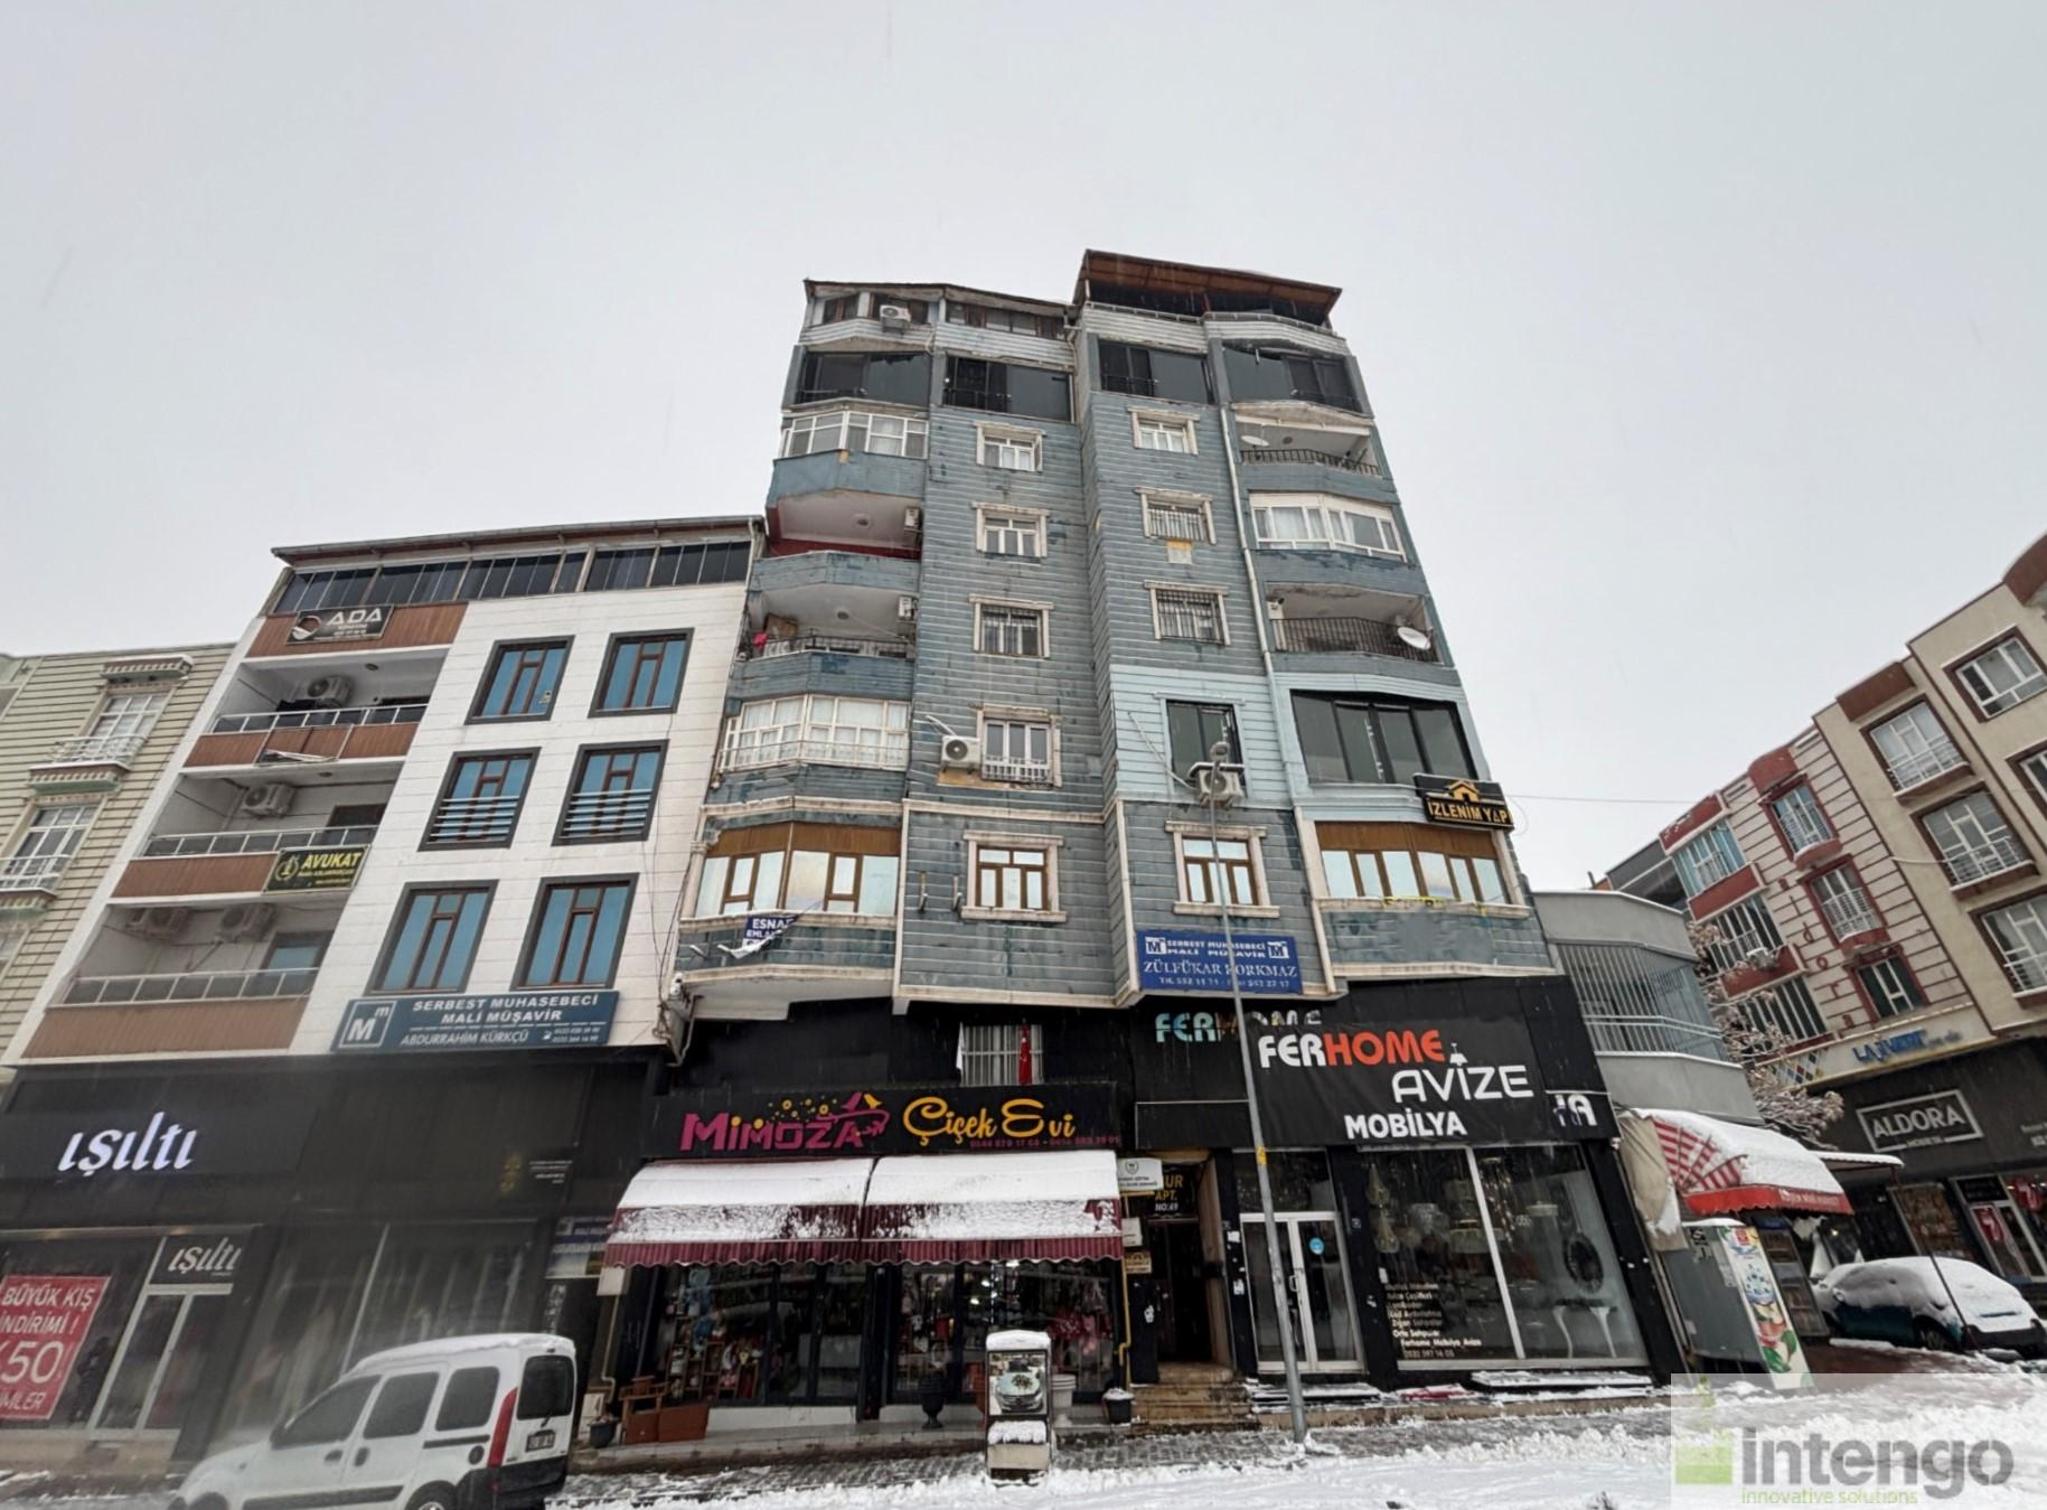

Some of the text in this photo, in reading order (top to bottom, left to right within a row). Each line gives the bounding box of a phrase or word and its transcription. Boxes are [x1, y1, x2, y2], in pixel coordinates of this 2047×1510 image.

[326, 608, 382, 626] ADA
[301, 852, 362, 869] AVUKAT
[1167, 940, 1205, 948] SERBEST
[1208, 949, 1266, 958] MÜAVİR
[1144, 958, 1222, 976] ZÜLFÜKAR
[413, 999, 488, 1012] SERBEST
[441, 1008, 563, 1025] MALİ MÜŞAVİR
[480, 1029, 530, 1045] KÜRKÇÜ
[1258, 1029, 1445, 1068] FERHOME
[1392, 1064, 1535, 1104] AVİZE
[903, 1096, 998, 1147] Çiçek
[1001, 1098, 1076, 1138] Evi
[1344, 1107, 1468, 1139] MOBİLYA
[1873, 1104, 1966, 1138] ALDORA
[2, 1283, 96, 1311] BÜYÜK KIŞ
